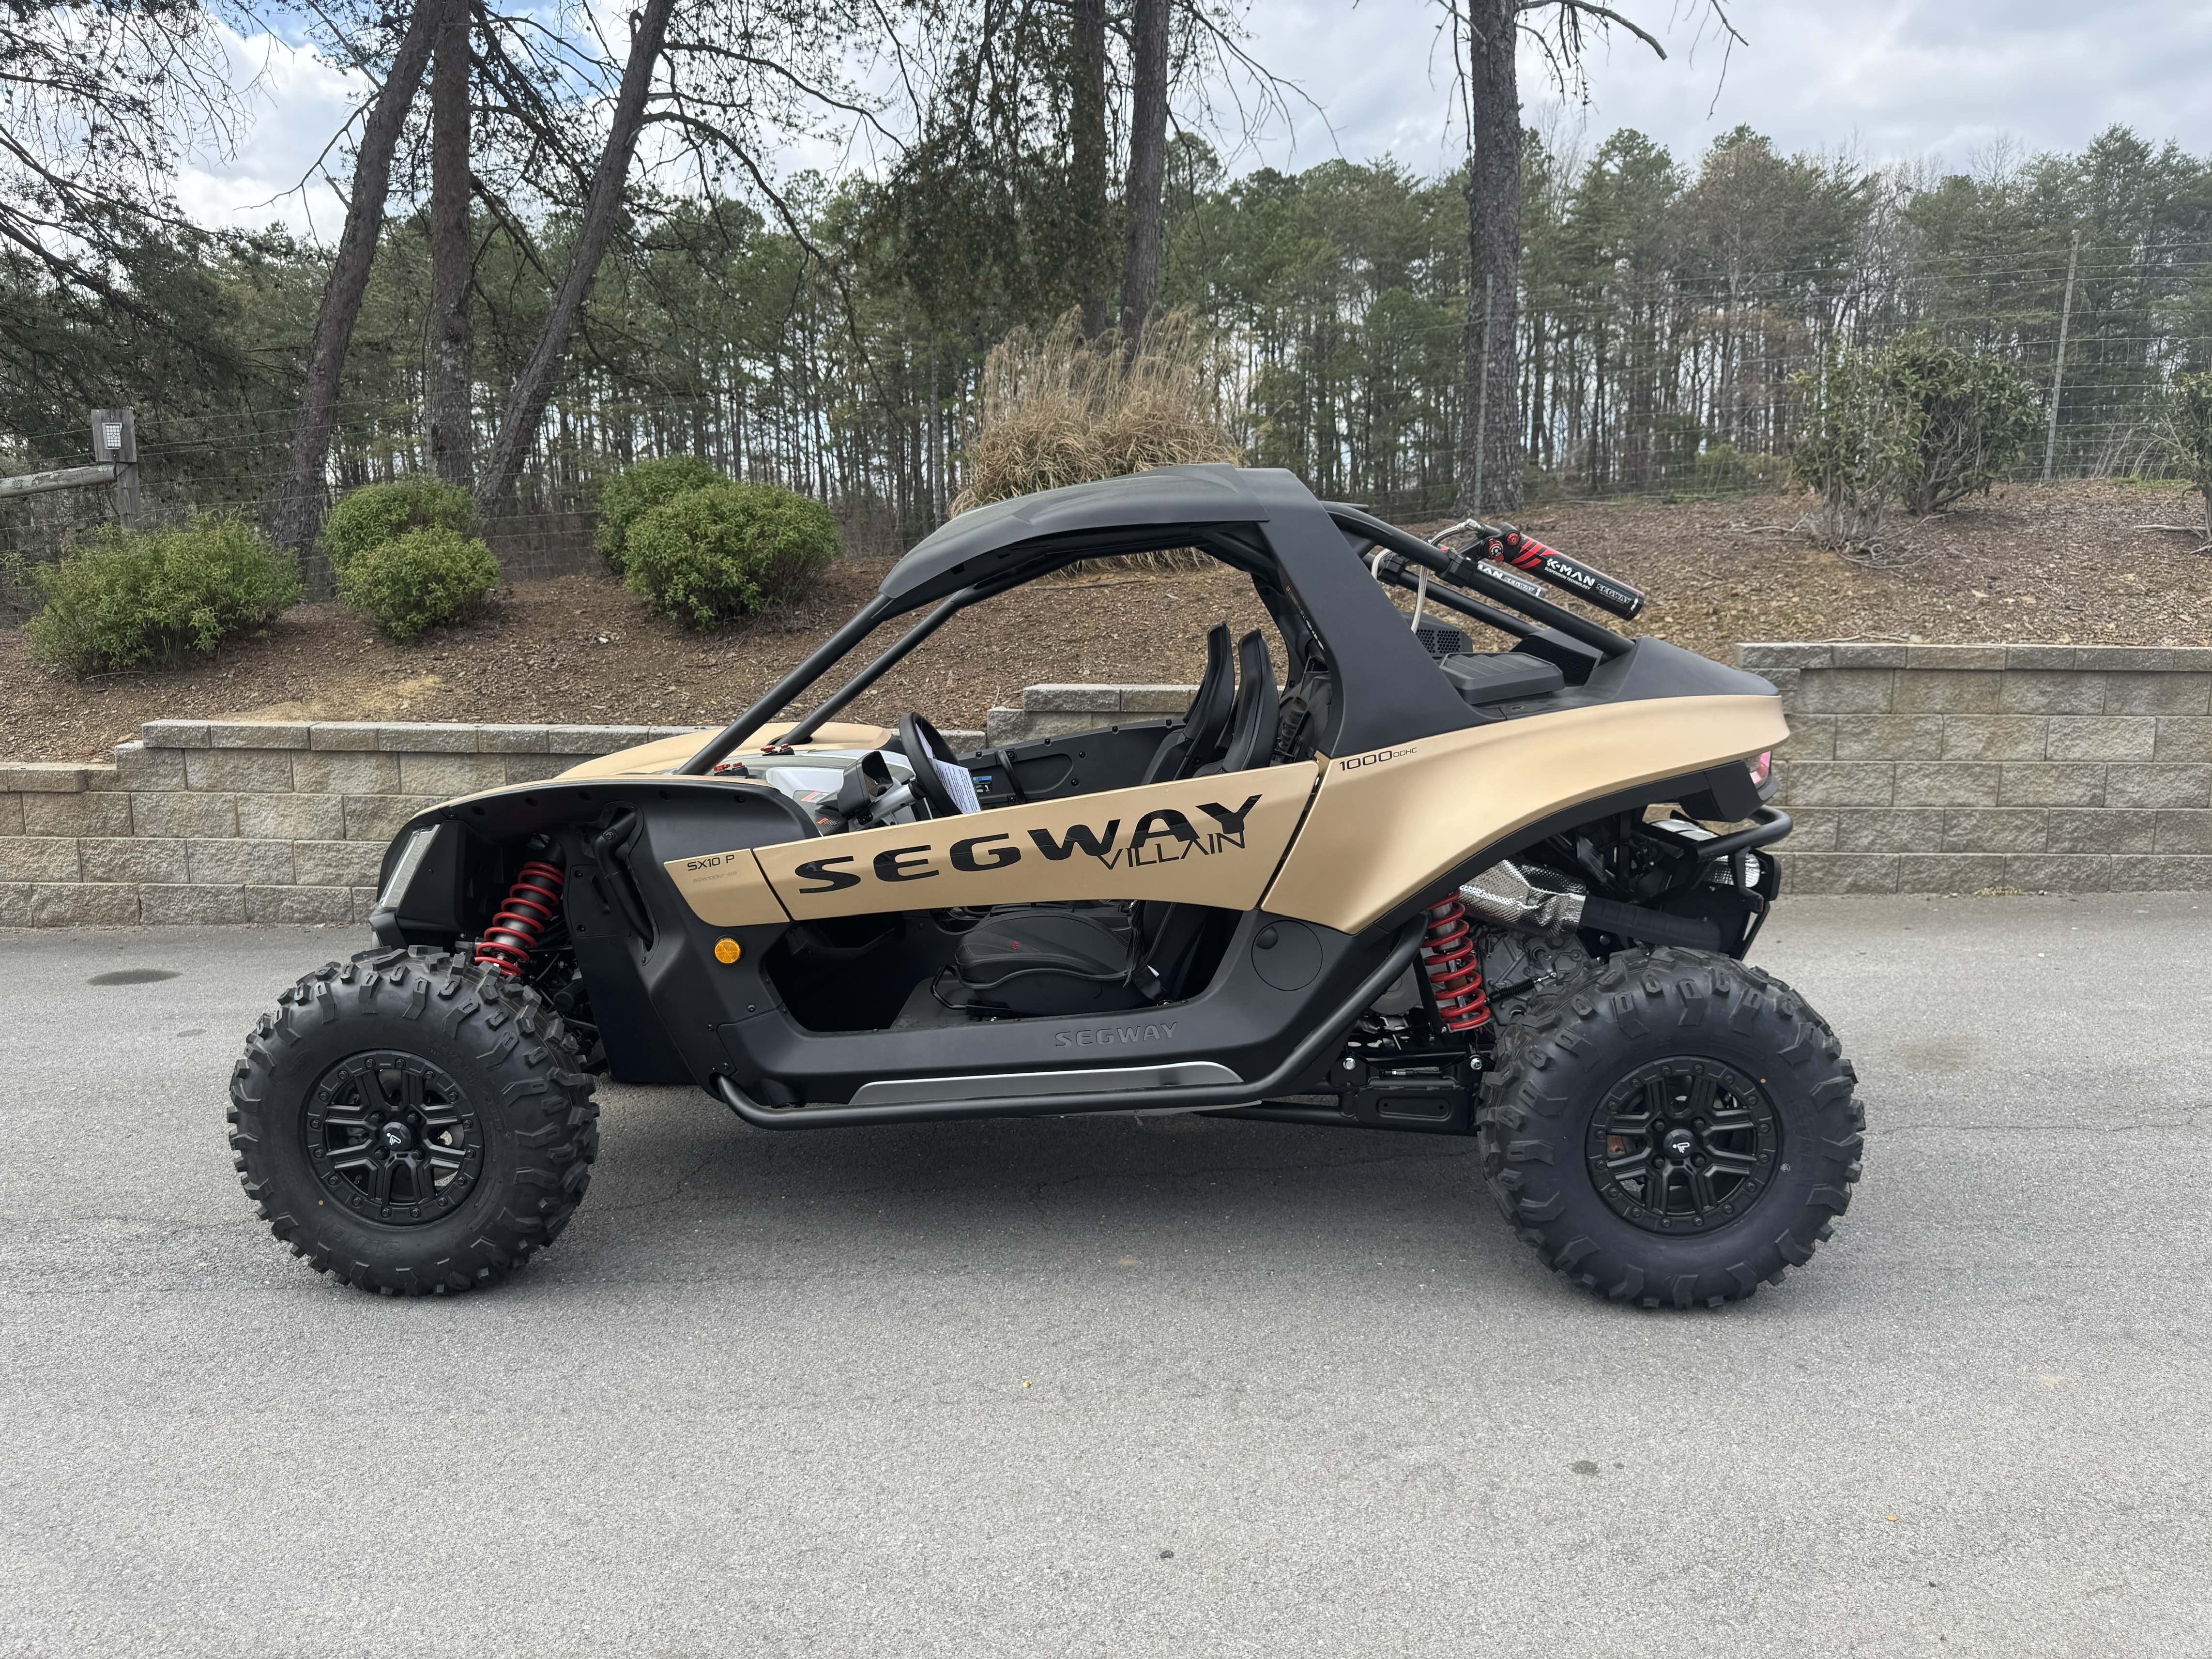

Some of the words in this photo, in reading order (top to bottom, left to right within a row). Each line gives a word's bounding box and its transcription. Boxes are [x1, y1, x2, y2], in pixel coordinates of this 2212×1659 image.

[1544, 566, 1567, 580] SUSPENSION
[1566, 577, 1591, 591] TECHNOLOGY
[1546, 558, 1596, 587] K-MAN
[1596, 583, 1632, 604] SEGWAY
[794, 794, 1263, 894] SEGWAY
[1096, 830, 1246, 870] VILLAIN
[687, 857, 720, 871] SX10
[726, 854, 735, 864] P
[1055, 1021, 1177, 1048] SEGWAY
